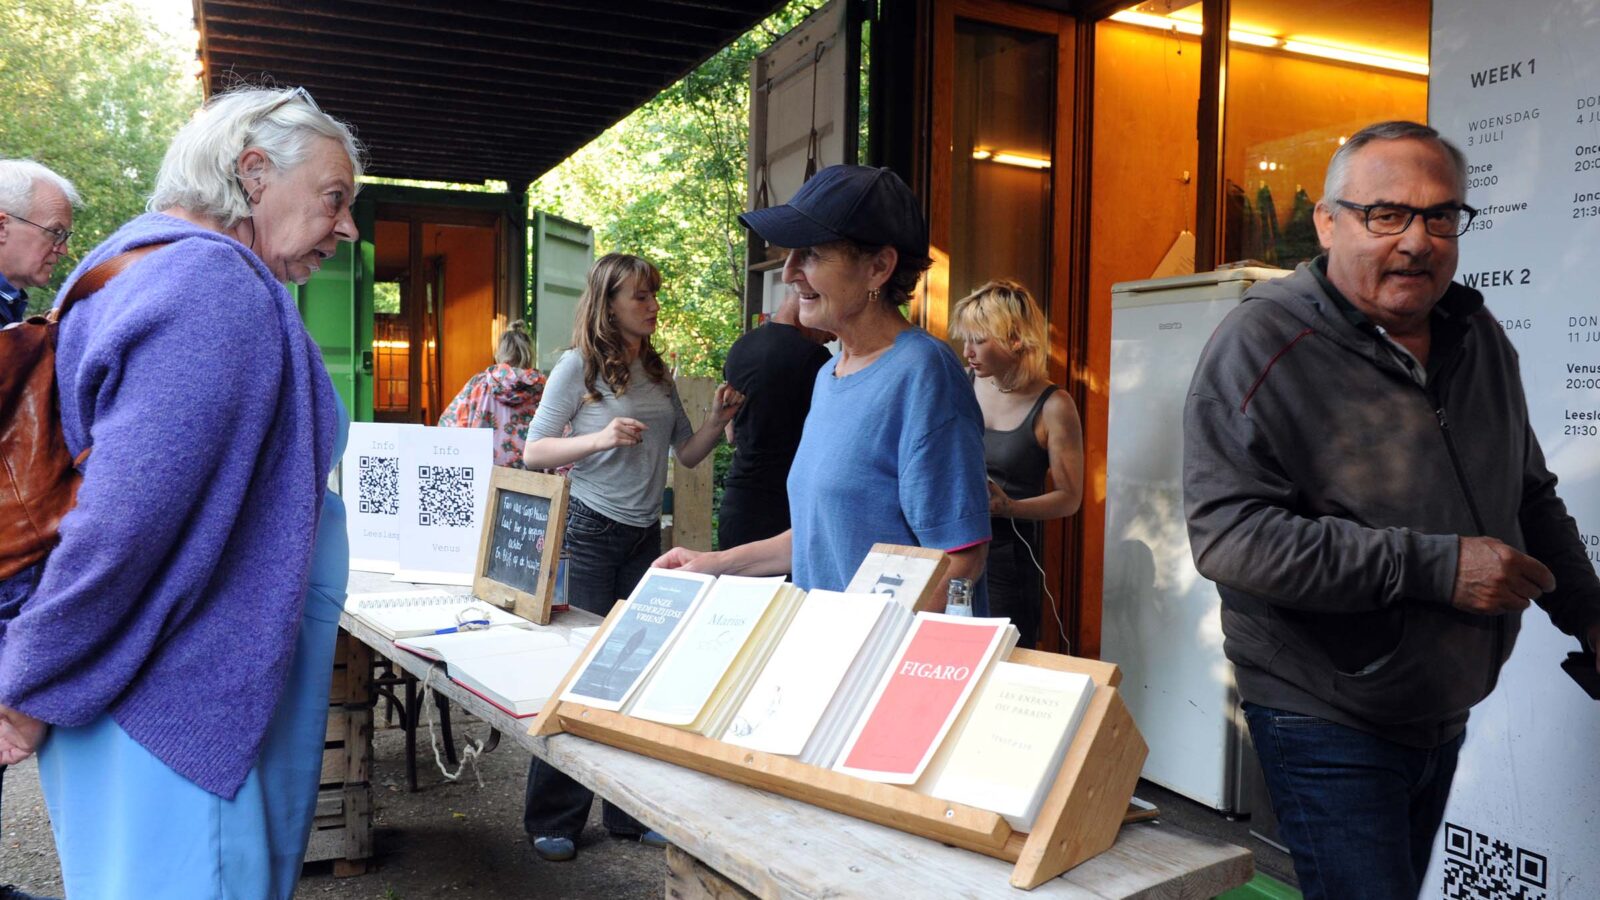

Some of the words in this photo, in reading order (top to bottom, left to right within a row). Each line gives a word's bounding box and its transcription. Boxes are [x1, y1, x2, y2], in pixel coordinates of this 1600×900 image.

[1471, 61, 1522, 88] WEEK
[1528, 59, 1535, 75] 1
[1468, 108, 1540, 132] WOENSDAG
[1577, 115, 1583, 125] 4
[1468, 137, 1474, 147] 3
[1479, 131, 1504, 145] JULI
[1467, 163, 1493, 175] Once
[1467, 175, 1498, 189] 20:00
[1476, 202, 1528, 216] ncfrouwe
[1463, 269, 1514, 289] WEEK
[1521, 268, 1531, 285] 2
[1568, 332, 1580, 342] 11
[1564, 425, 1597, 436] 21:30
[372, 440, 395, 451] Info
[433, 445, 460, 456] Info
[432, 543, 461, 553] Venus
[650, 596, 673, 608] ONZE
[631, 603, 684, 618] WEDERZIJDSE
[636, 612, 666, 625] VRIEND
[707, 613, 746, 626] Marius
[900, 661, 969, 681] FIGARO
[999, 690, 1015, 700] LES
[1018, 693, 1060, 707] ENFANTS
[1012, 706, 1053, 720] PARADIS
